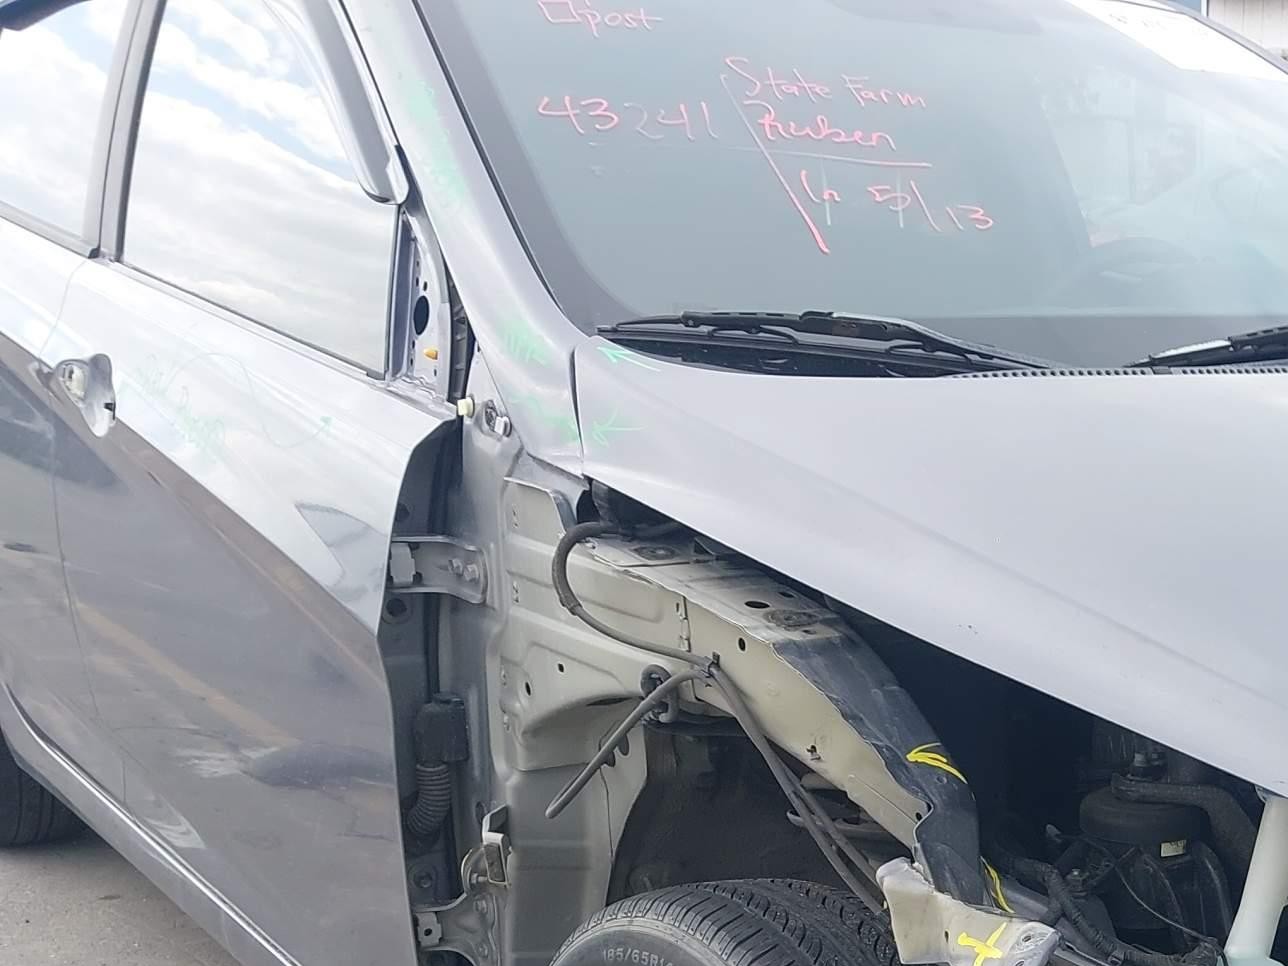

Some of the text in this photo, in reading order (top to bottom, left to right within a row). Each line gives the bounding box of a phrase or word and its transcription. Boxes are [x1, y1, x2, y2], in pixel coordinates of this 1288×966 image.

[725, 56, 927, 108] State Farm
[538, 95, 719, 141] 43241
